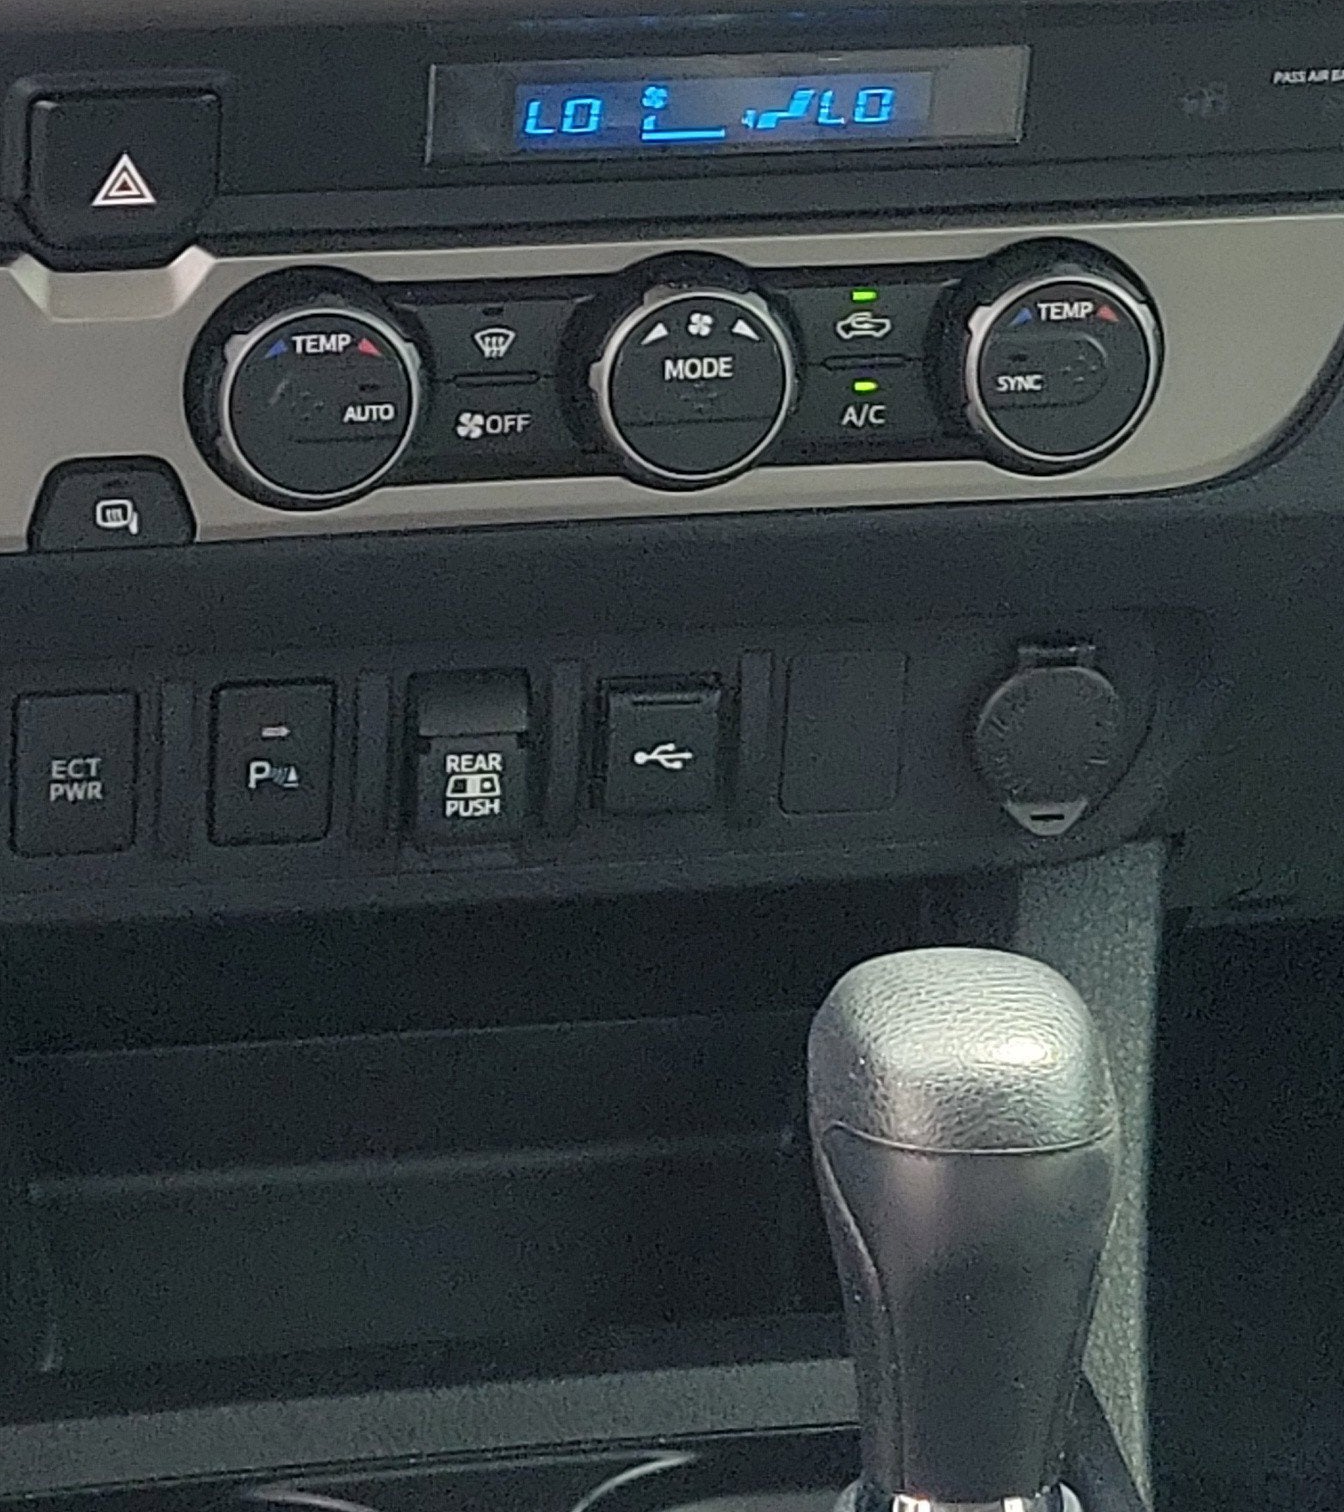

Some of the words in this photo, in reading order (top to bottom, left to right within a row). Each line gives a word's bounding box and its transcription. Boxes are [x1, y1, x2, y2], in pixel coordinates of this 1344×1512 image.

[1273, 70, 1306, 85] PASS
[1038, 300, 1093, 323] TEMP
[291, 333, 351, 354] TEMP
[664, 356, 733, 381] MODE
[996, 374, 1043, 392] SYNC
[343, 403, 395, 423] AUTO
[485, 413, 531, 434] OFF
[841, 403, 886, 428] A/C
[51, 757, 102, 778] ECT
[445, 752, 503, 772] REAR
[248, 760, 271, 789] P
[49, 781, 104, 801] PWR
[445, 798, 502, 817] PUSH
